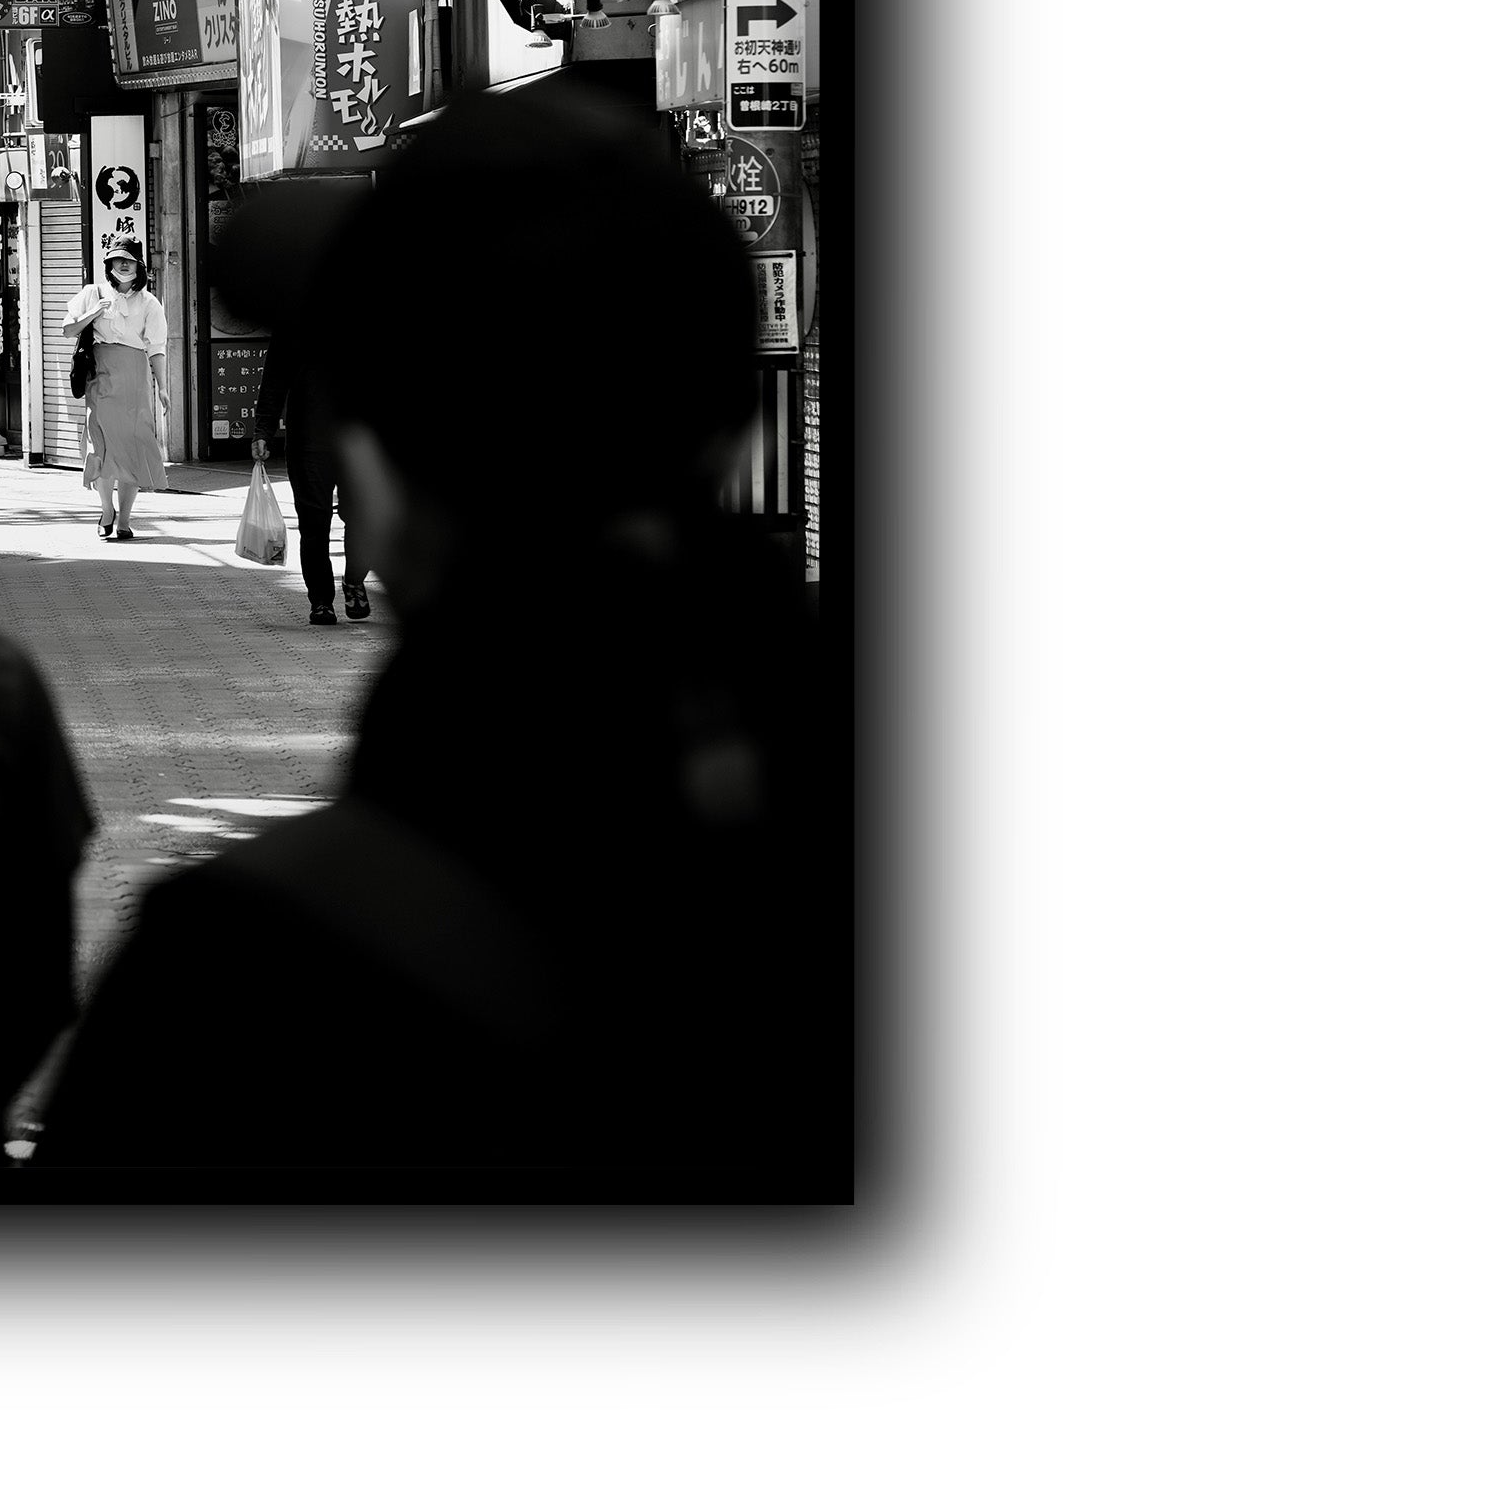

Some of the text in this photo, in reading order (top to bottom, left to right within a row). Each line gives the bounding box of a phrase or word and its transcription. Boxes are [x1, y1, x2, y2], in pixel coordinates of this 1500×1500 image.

[19, 6, 39, 25] 6F
[735, 40, 800, 57] お初天神通り
[312, 19, 328, 100] HORUMON
[737, 59, 799, 75] 右へ60m
[733, 87, 755, 95] ここは
